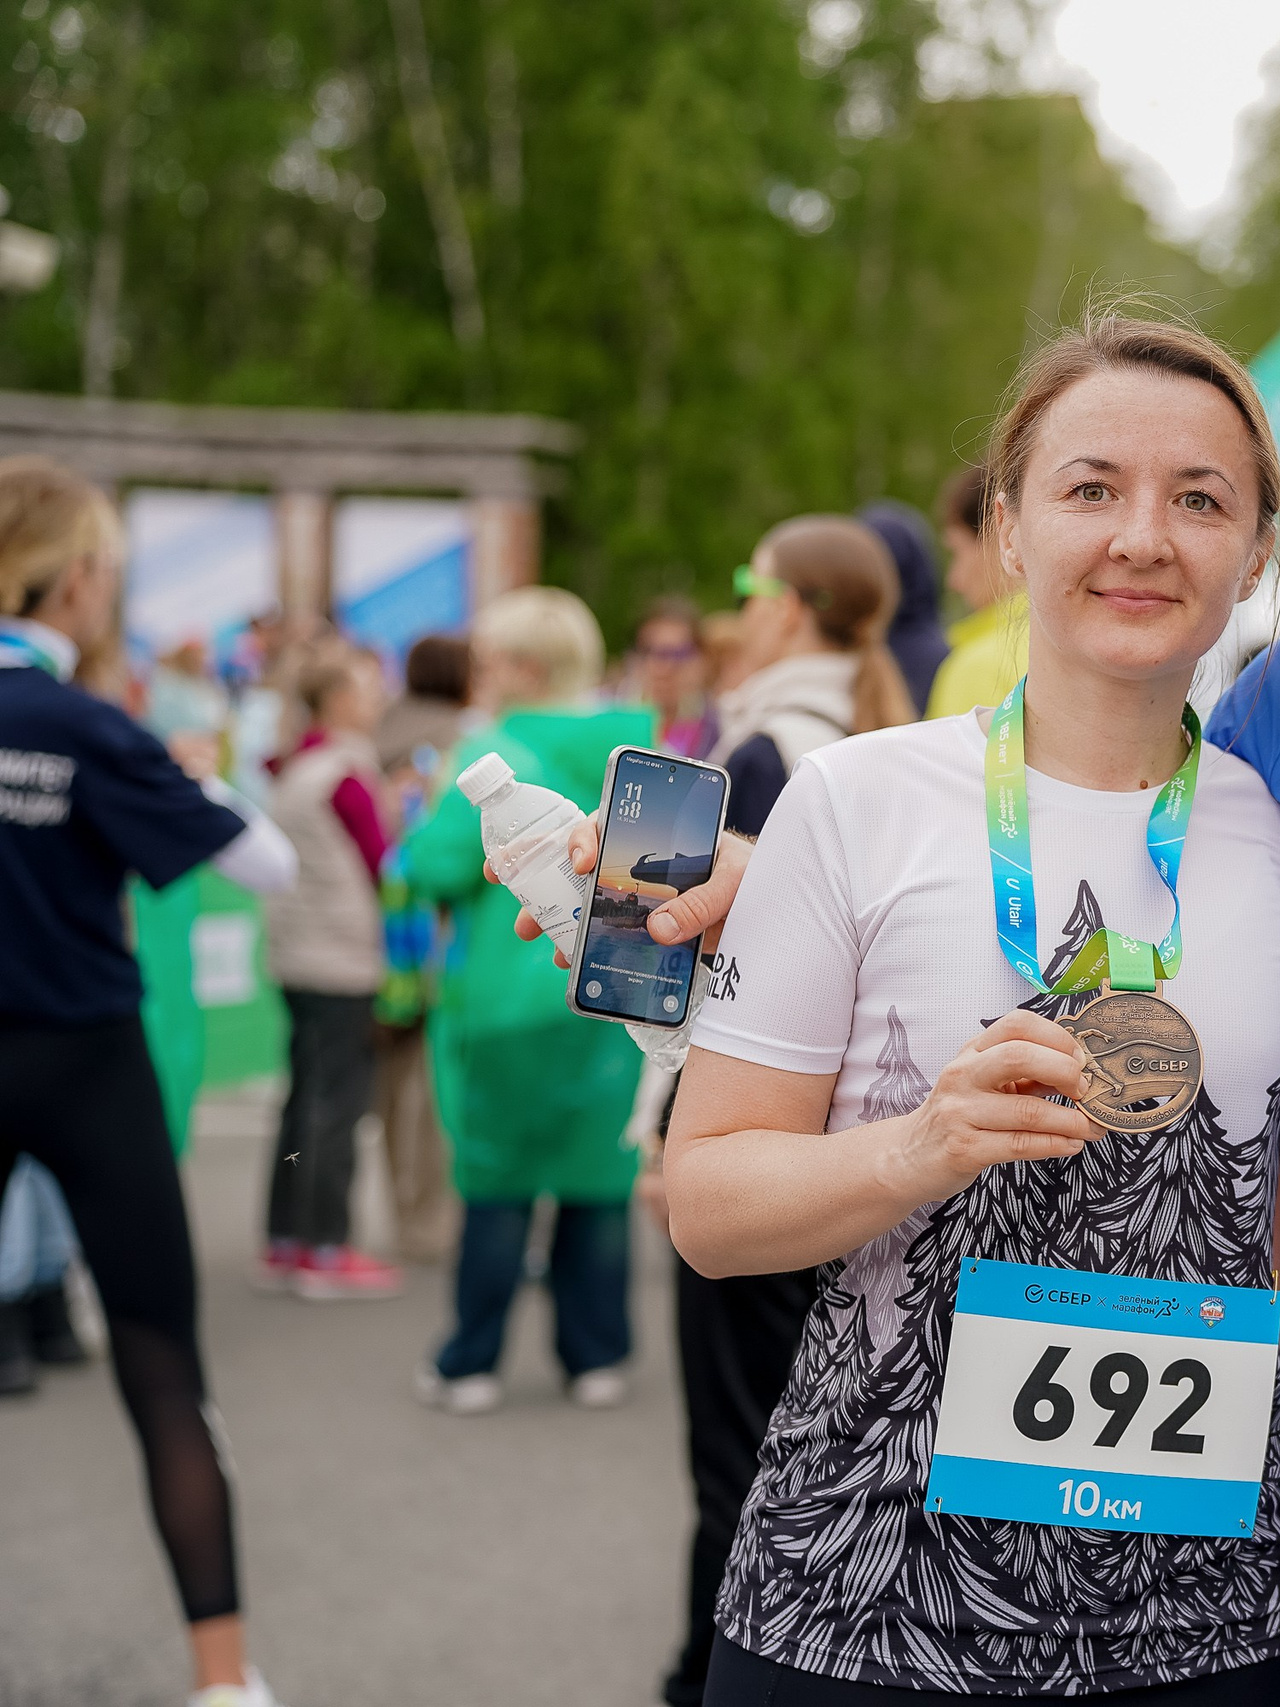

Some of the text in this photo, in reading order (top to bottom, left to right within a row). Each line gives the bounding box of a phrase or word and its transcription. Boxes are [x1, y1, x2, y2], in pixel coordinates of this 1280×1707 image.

[998, 722, 1010, 765] 185 лет
[625, 782, 642, 800] 11
[619, 799, 641, 819] 58
[1005, 788, 1015, 822] зелёный
[1009, 897, 1022, 928] Utair
[1069, 951, 1109, 992] 185 лет
[1149, 1058, 1188, 1071] СБЕР
[1090, 1106, 1176, 1124] зелёный марафон
[1048, 1289, 1091, 1306] СБЕР
[1119, 1294, 1160, 1306] зелёный
[1112, 1303, 1155, 1315] марафон
[1012, 1345, 1212, 1455] 692
